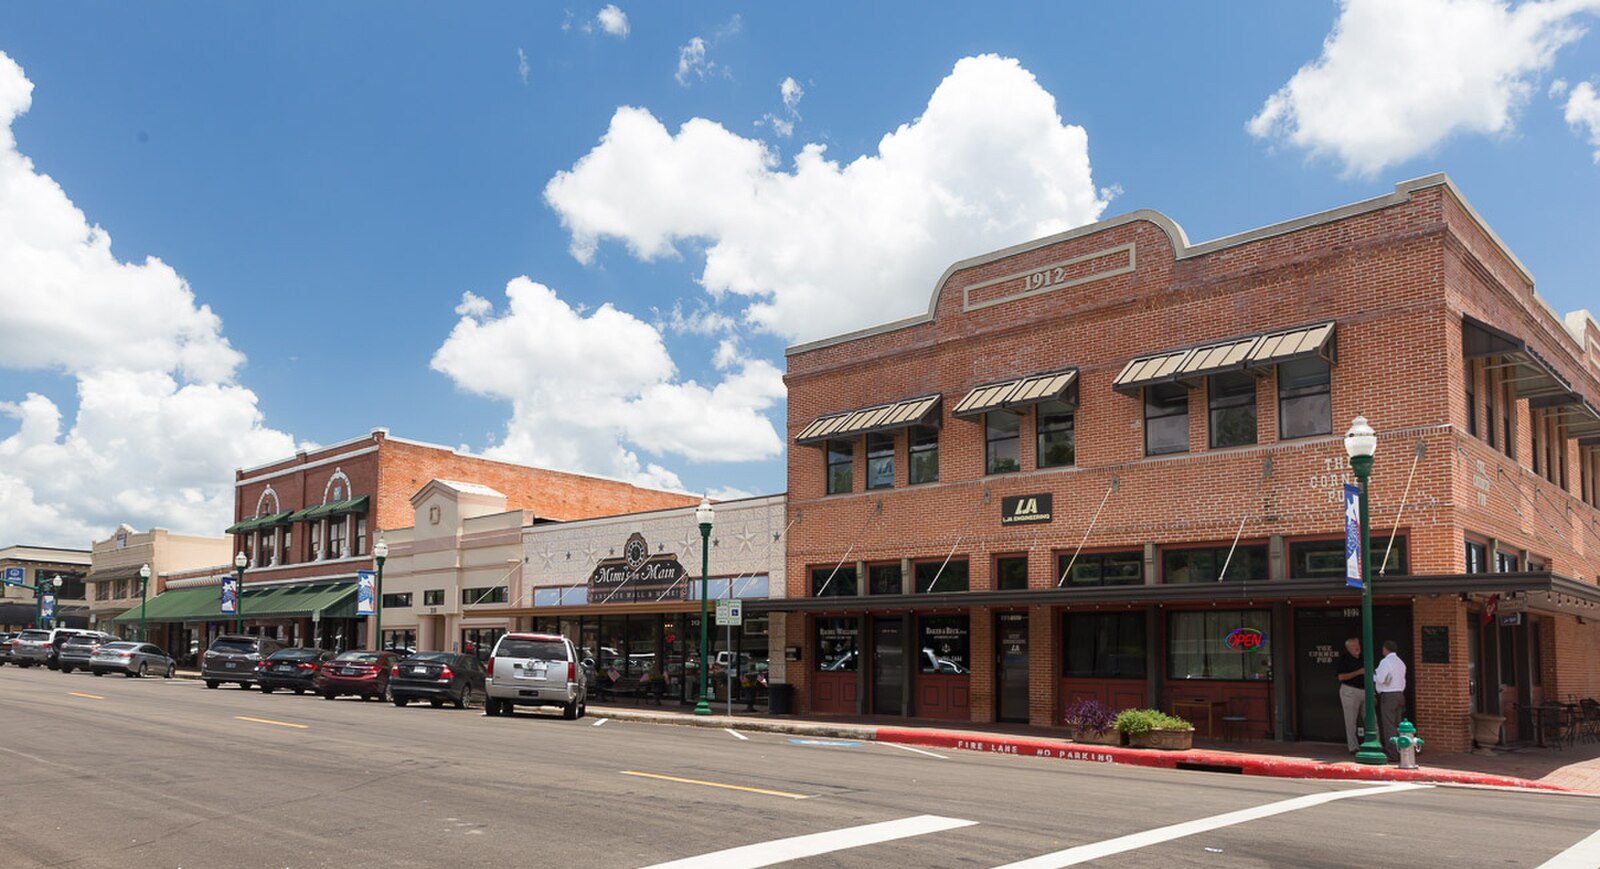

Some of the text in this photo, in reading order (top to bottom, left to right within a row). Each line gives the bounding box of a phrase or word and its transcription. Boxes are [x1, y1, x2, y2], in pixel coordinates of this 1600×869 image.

[1024, 267, 1065, 291] 1912
[1013, 513, 1050, 522] ENGINEERING
[641, 563, 675, 581] Main
[1228, 633, 1263, 647] OPEN
[957, 740, 1114, 763] FIRE LANE NO PARKING
